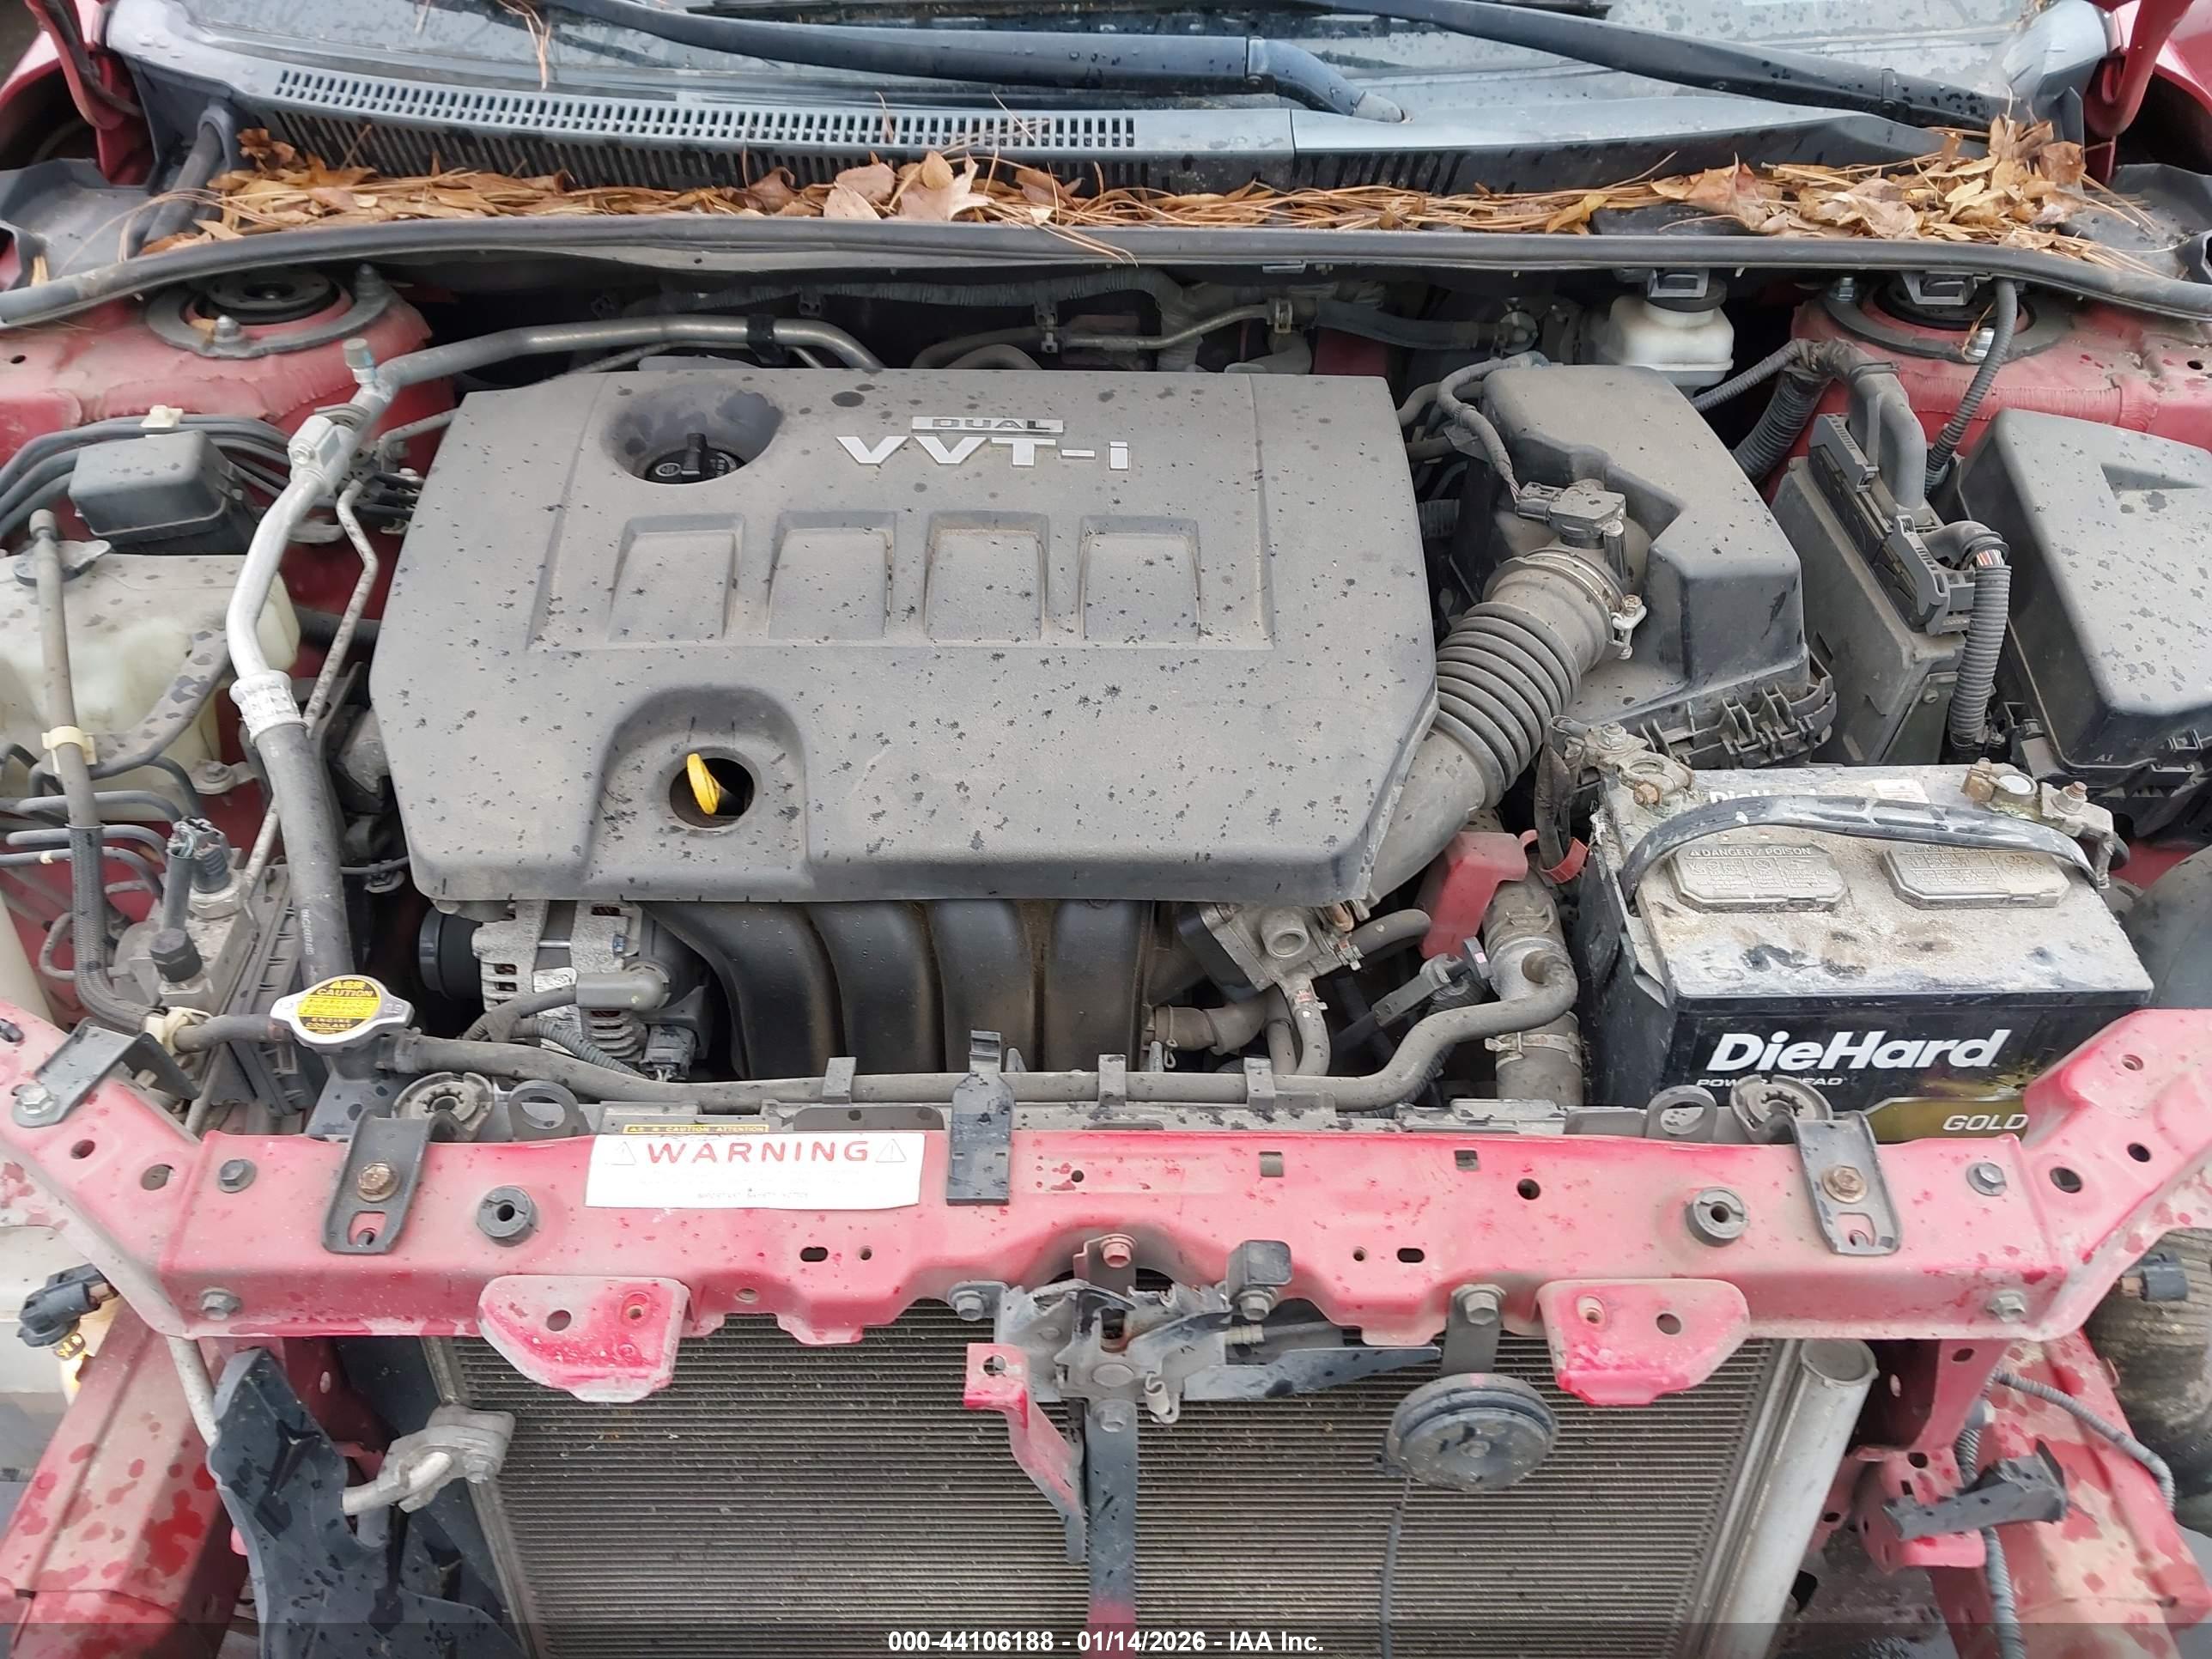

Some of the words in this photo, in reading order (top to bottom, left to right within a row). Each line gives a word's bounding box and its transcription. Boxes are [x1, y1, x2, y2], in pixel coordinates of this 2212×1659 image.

[932, 418, 1052, 431] DUAL
[836, 435, 1130, 471] VVT-i
[316, 988, 374, 997] CAUTION
[1705, 1029, 2011, 1072] DieHard
[1942, 1114, 2029, 1131] GOLD
[647, 1140, 869, 1164] WARNING
